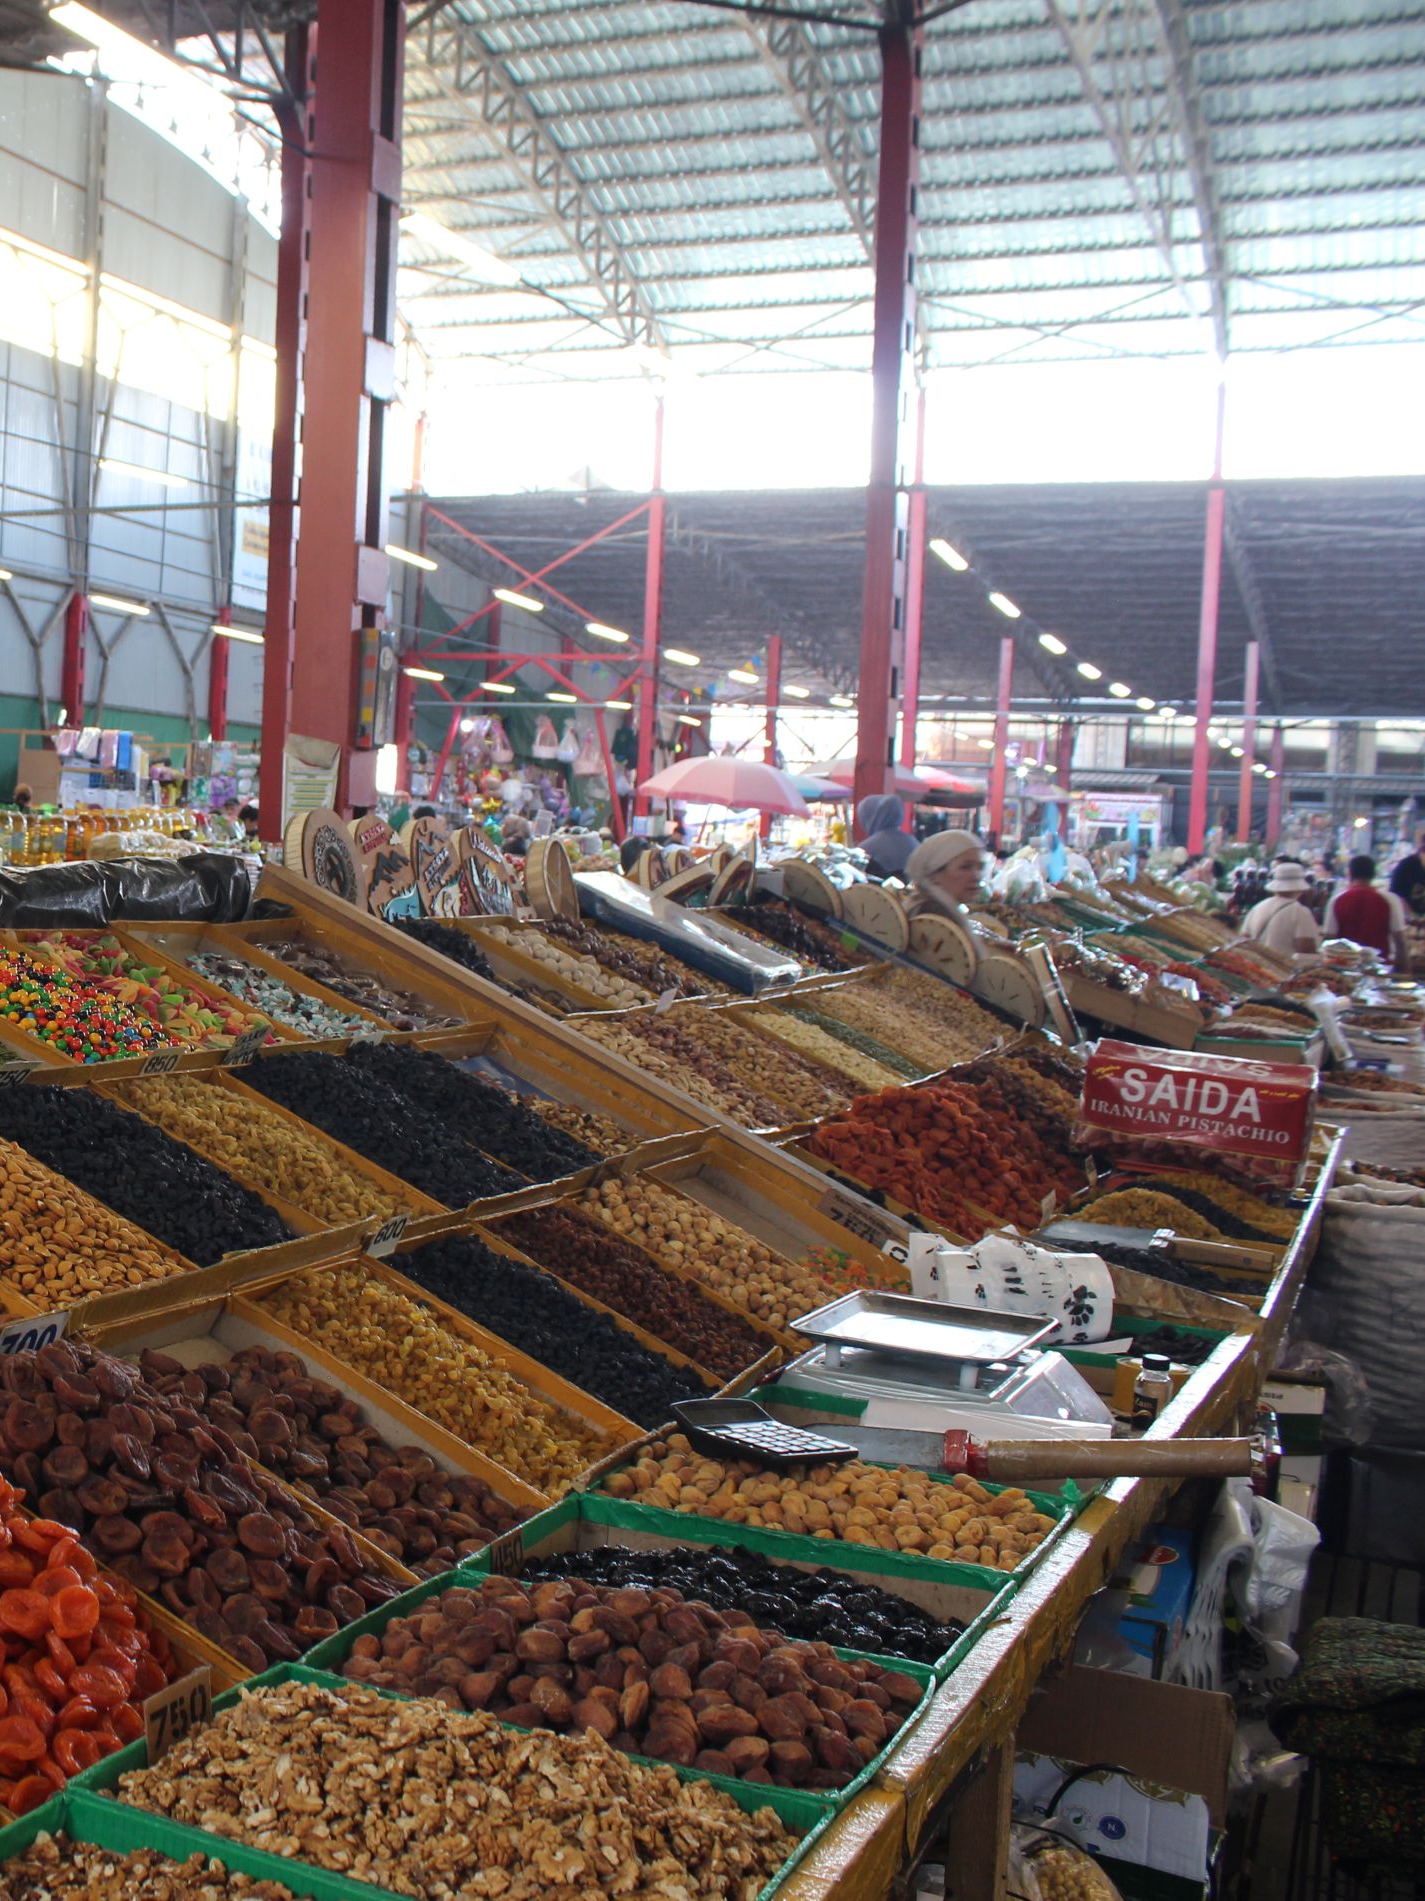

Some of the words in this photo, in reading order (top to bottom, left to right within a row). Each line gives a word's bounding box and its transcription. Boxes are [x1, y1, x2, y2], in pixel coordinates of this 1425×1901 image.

[1120, 1068, 1262, 1122] SAIDA
[1090, 1098, 1171, 1124] IRANIAN
[1177, 1115, 1290, 1145] PISTACHIO
[373, 1217, 408, 1245] 600
[1, 1324, 57, 1354] 700
[150, 1684, 207, 1751] 750
